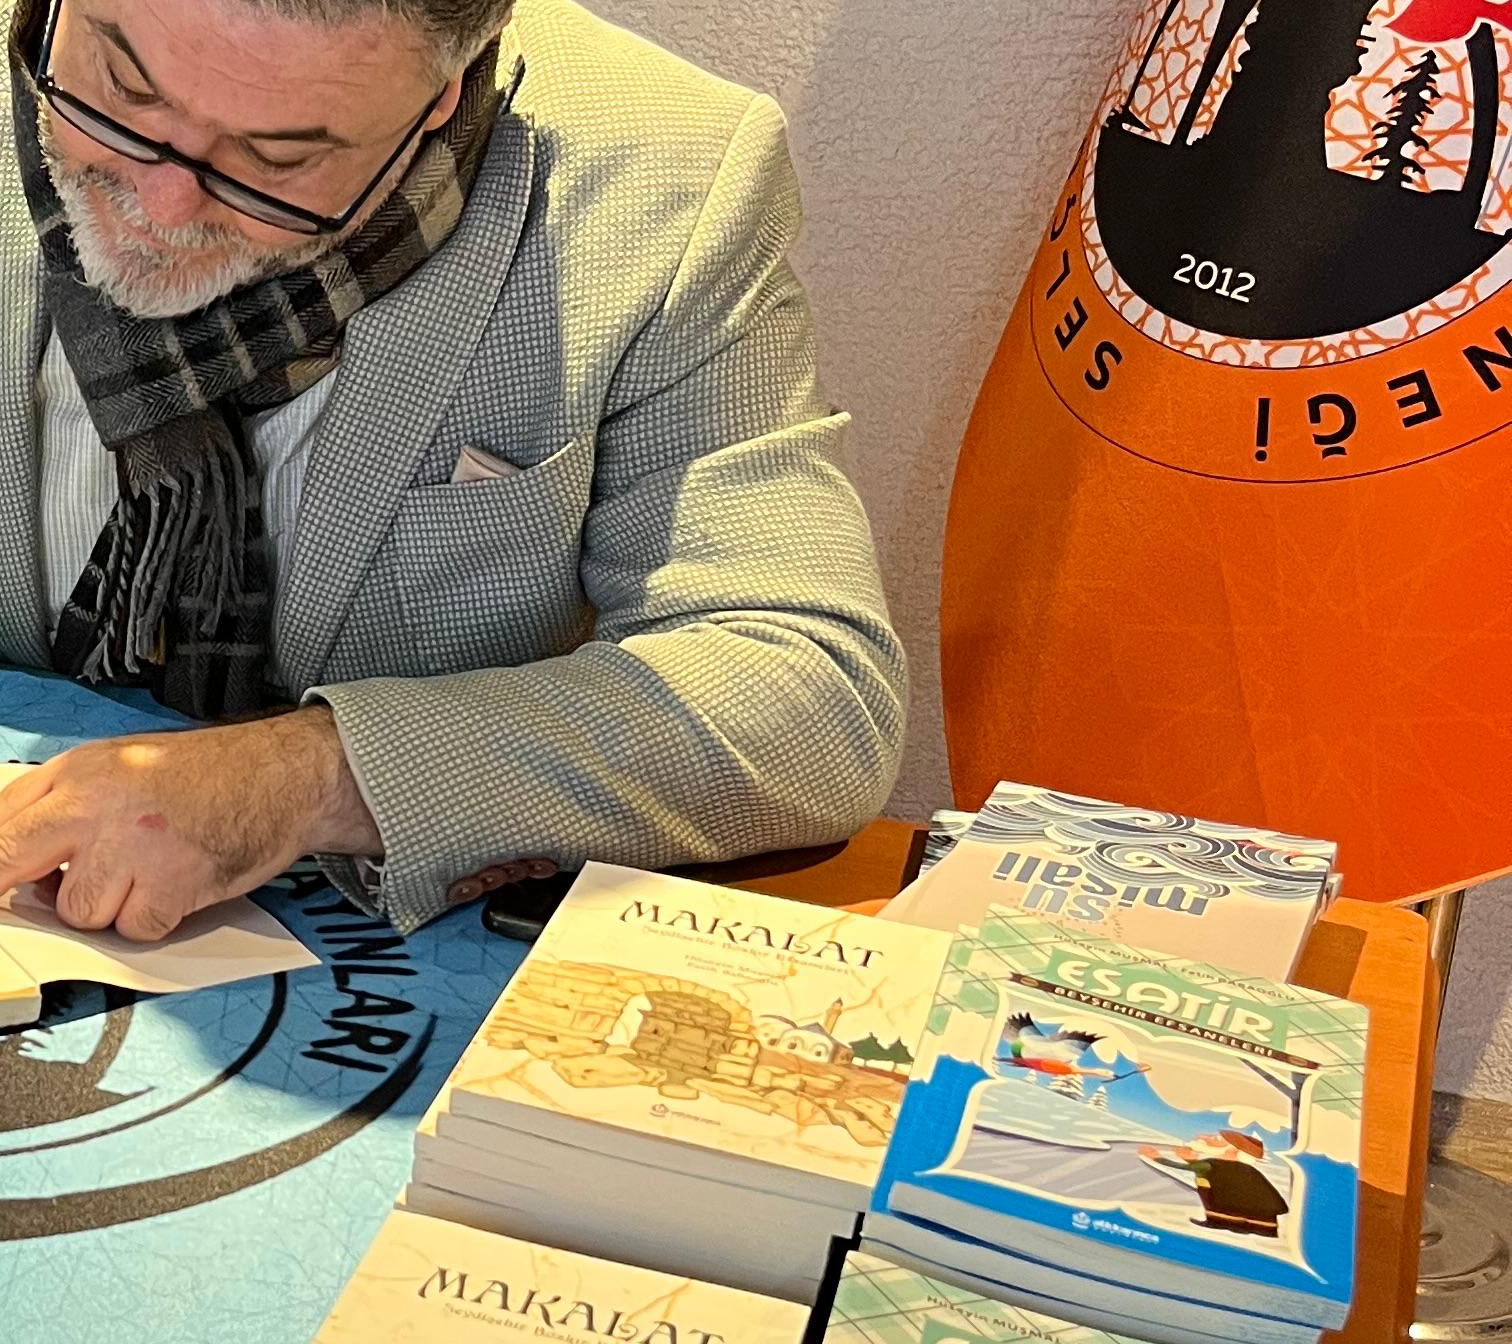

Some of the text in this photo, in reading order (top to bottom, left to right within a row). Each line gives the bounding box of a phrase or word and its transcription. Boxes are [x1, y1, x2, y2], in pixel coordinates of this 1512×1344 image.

[1171, 253, 1257, 304] 2012
[1255, 325, 1512, 462] NEĞİ
[619, 900, 884, 969] MAKALAT
[1056, 959, 1274, 1044] ESATİR
[1153, 1013, 1274, 1058] EFSANELERİ
